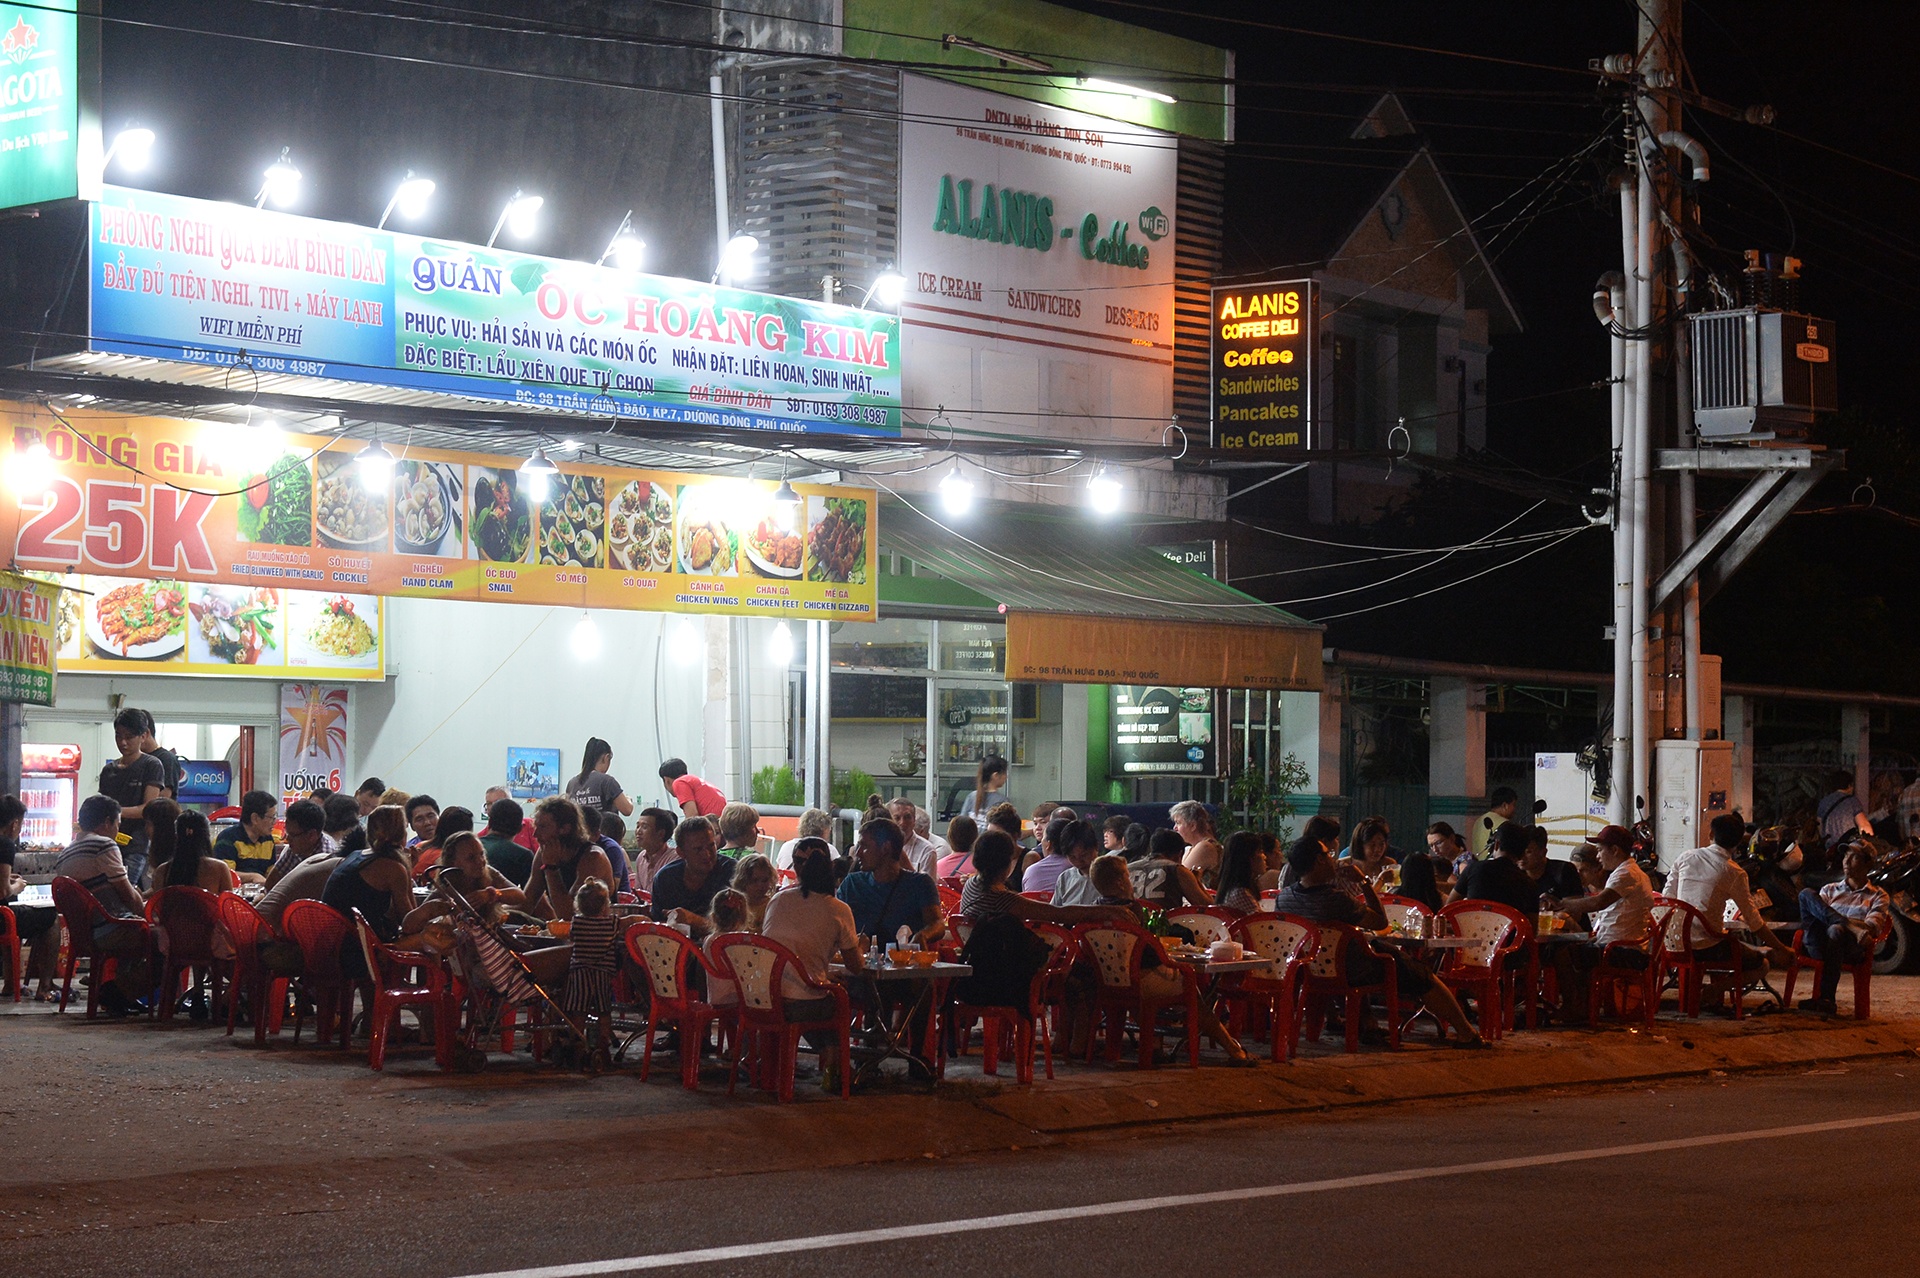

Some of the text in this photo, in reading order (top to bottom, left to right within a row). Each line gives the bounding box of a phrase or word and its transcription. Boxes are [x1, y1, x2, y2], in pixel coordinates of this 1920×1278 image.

[985, 108, 1010, 127] DNTN
[1013, 113, 1032, 132] NHÀ
[1036, 118, 1060, 136] HÀNG
[932, 174, 1054, 252] ALANIS
[1080, 212, 1149, 270] Coffee
[104, 252, 138, 290] ĐẦY
[142, 261, 164, 295] ĐỦ
[170, 269, 206, 304] TIỆN
[212, 279, 253, 307] NGHI.
[259, 286, 289, 312] TIVI
[307, 289, 339, 319] MÁY
[343, 298, 382, 328] LẠNH
[413, 256, 502, 295] QUÁN
[802, 321, 888, 368] KIM
[917, 272, 1159, 331] ICE CREAM SANDWICHES DESSERTS
[1220, 291, 1300, 320] ALANIS
[199, 315, 303, 345] WIFI MIỄN PHÍ
[1221, 318, 1299, 340] COFFEE DELI
[404, 311, 447, 340] PHỤC
[452, 318, 476, 343] VỤ:
[482, 317, 507, 344] HẢI
[512, 322, 541, 350] SẢN
[547, 328, 565, 353] VÀ
[569, 332, 598, 358] CÁC
[602, 337, 634, 362] MÓN
[638, 338, 657, 365] ỐC
[672, 346, 706, 374] NHẬN
[710, 350, 739, 378] ĐẶT:
[742, 355, 770, 379] LIÊN
[774, 363, 808, 388] HOAN,
[812, 369, 839, 389] SINH
[1223, 347, 1294, 368] Coffee
[257, 356, 285, 371] 308
[290, 359, 326, 376] 4987
[404, 342, 437, 370] ĐẶC
[442, 348, 482, 374] BIỆT:
[487, 349, 516, 377] LẨU
[520, 358, 555, 383] XIÊN
[559, 366, 588, 387] QUE
[616, 374, 654, 397] CHỌN
[1220, 374, 1299, 396] Sandwiches
[688, 383, 772, 410] GIÁ BÌNH DÂN
[515, 389, 535, 402] ĐC:
[556, 392, 587, 409] TRẦN
[624, 403, 650, 419] ĐẠO,
[653, 406, 681, 422] KP.7,
[722, 412, 750, 428] ĐÔNG
[786, 396, 887, 424] SĐT: 0169 308 4987
[1219, 402, 1299, 421] Pancakes
[1220, 430, 1299, 449] Ice Cream
[14, 477, 218, 574] 25K
[1185, 551, 1206, 563] Deli
[232, 564, 250, 574] FRIED
[285, 568, 301, 578] WITH
[302, 570, 324, 579] GARLIC
[332, 572, 368, 583] COCKLE
[402, 577, 453, 589] HAND CLAM
[488, 583, 513, 592] SNAIL
[675, 594, 739, 606] CHICKEN WINGS
[746, 597, 800, 608] CHICKEN FEET
[803, 601, 870, 612] CHICKEN GIZZARD
[19, 628, 49, 667] VIÊN
[1039, 666, 1049, 674] 98
[194, 771, 224, 786] pepsi
[284, 768, 341, 792] UỐNG 6
